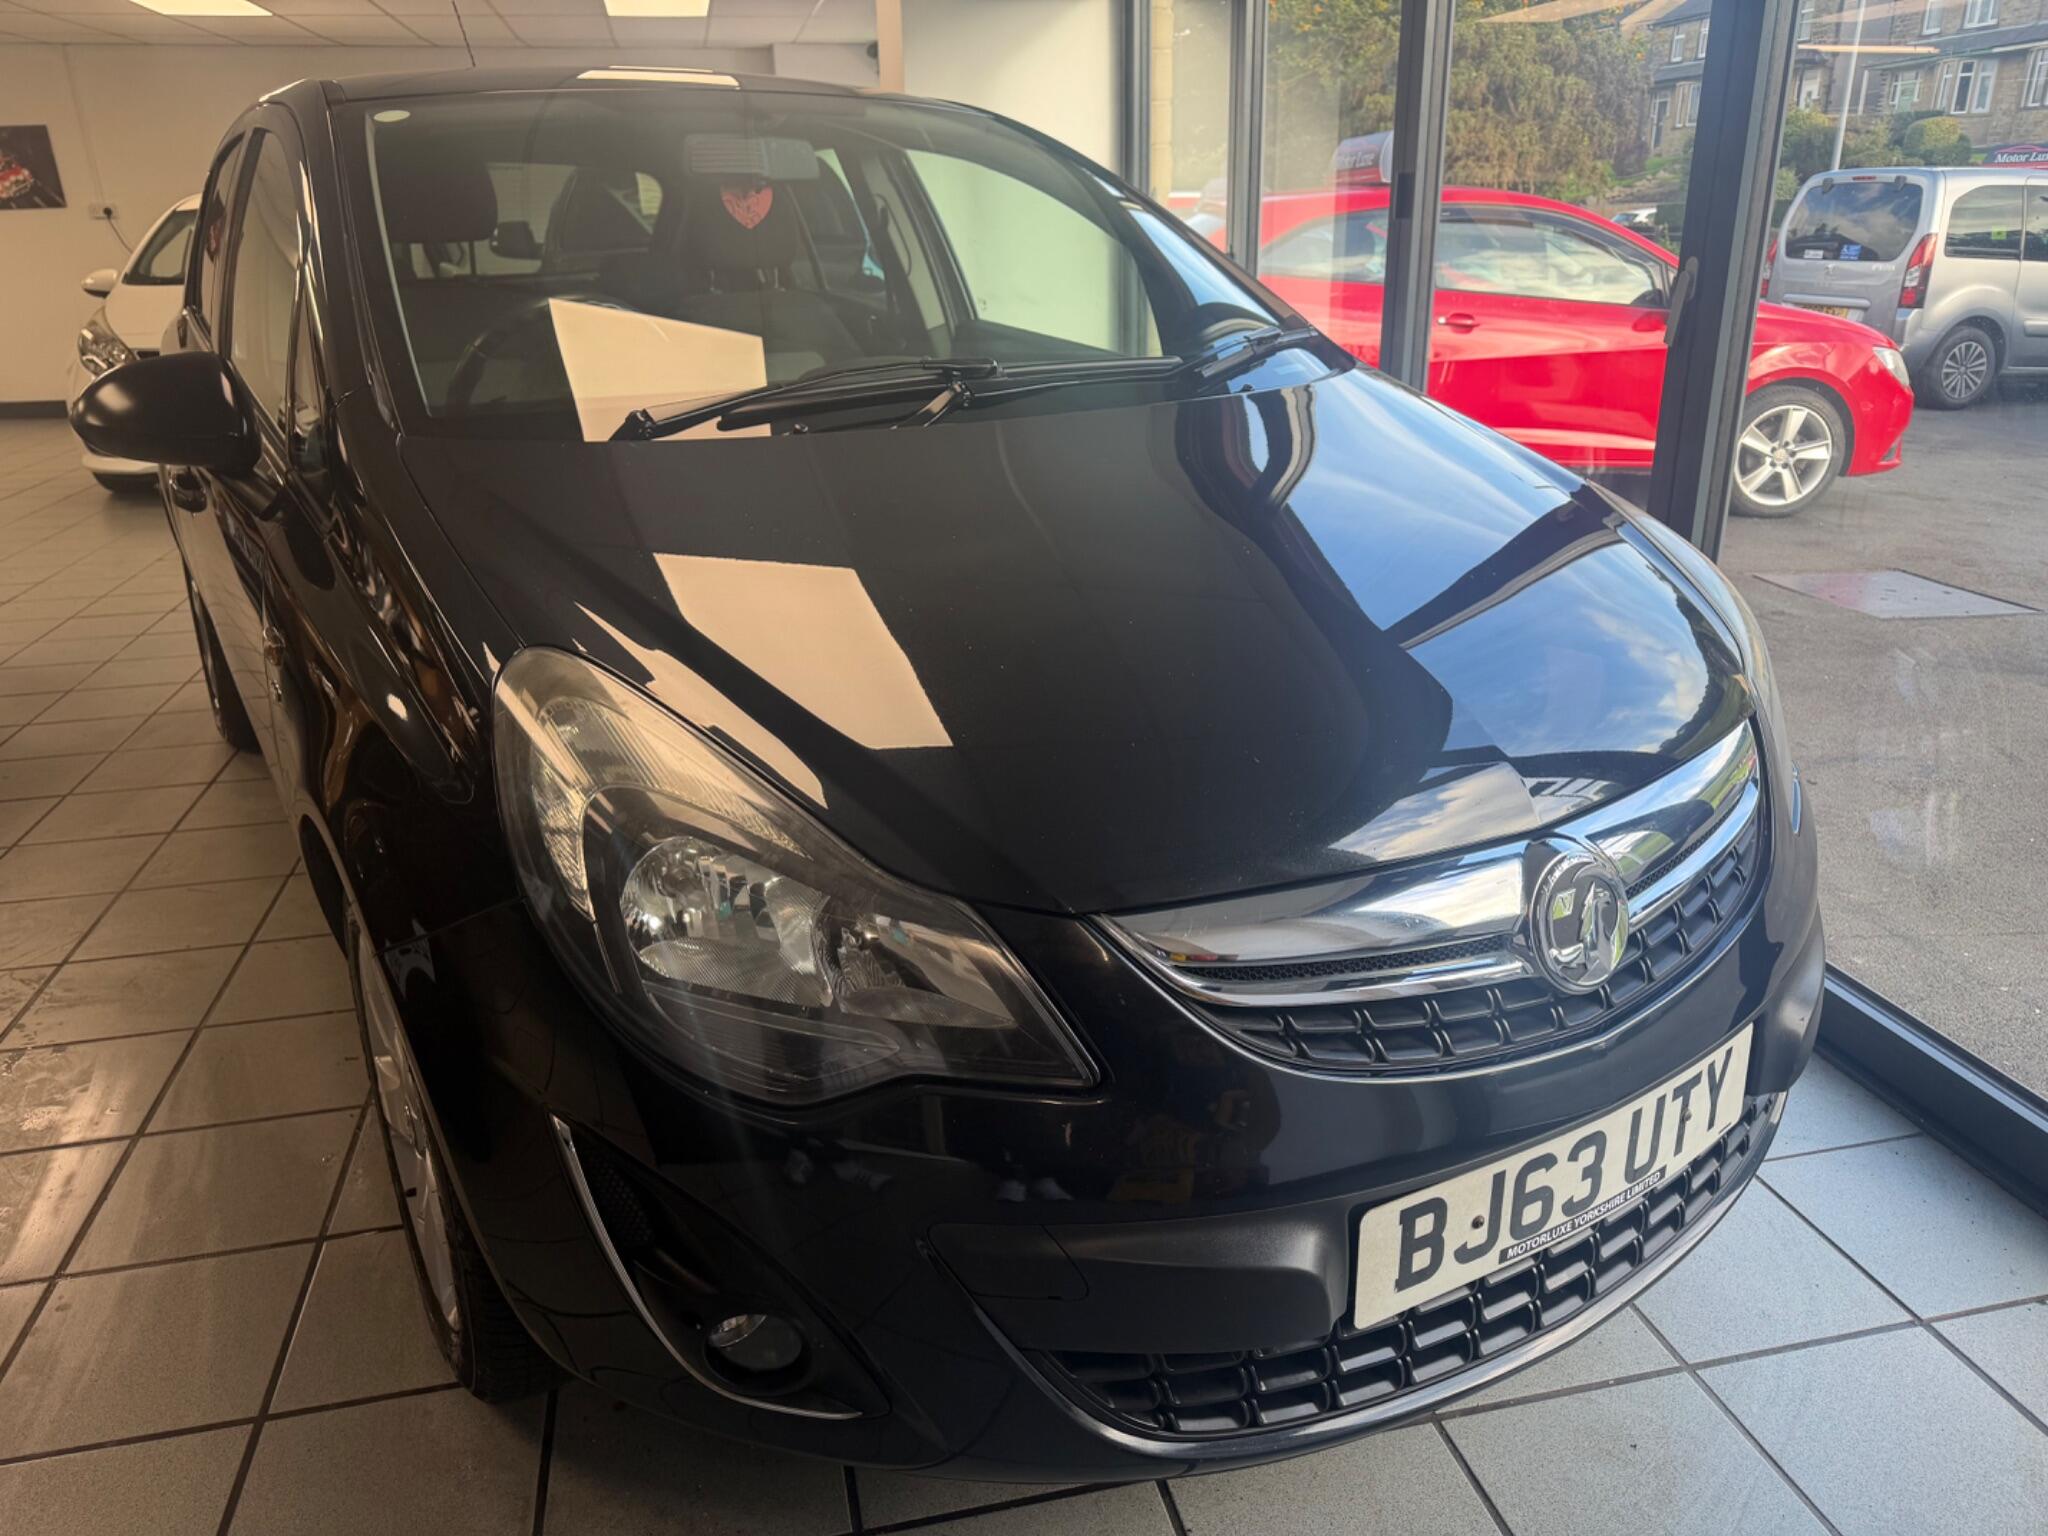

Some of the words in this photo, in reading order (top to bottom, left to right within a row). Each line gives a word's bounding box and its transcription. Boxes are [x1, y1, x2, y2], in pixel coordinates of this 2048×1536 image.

[1995, 153, 2030, 163] Motor
[1395, 1130, 1607, 1292] BJ63
[1625, 1047, 1734, 1184] UTY
[1507, 1222, 1573, 1259] MOTORLUXE
[1573, 1190, 1626, 1226] YORKSHIRE
[1626, 1171, 1661, 1200] LIMITED
